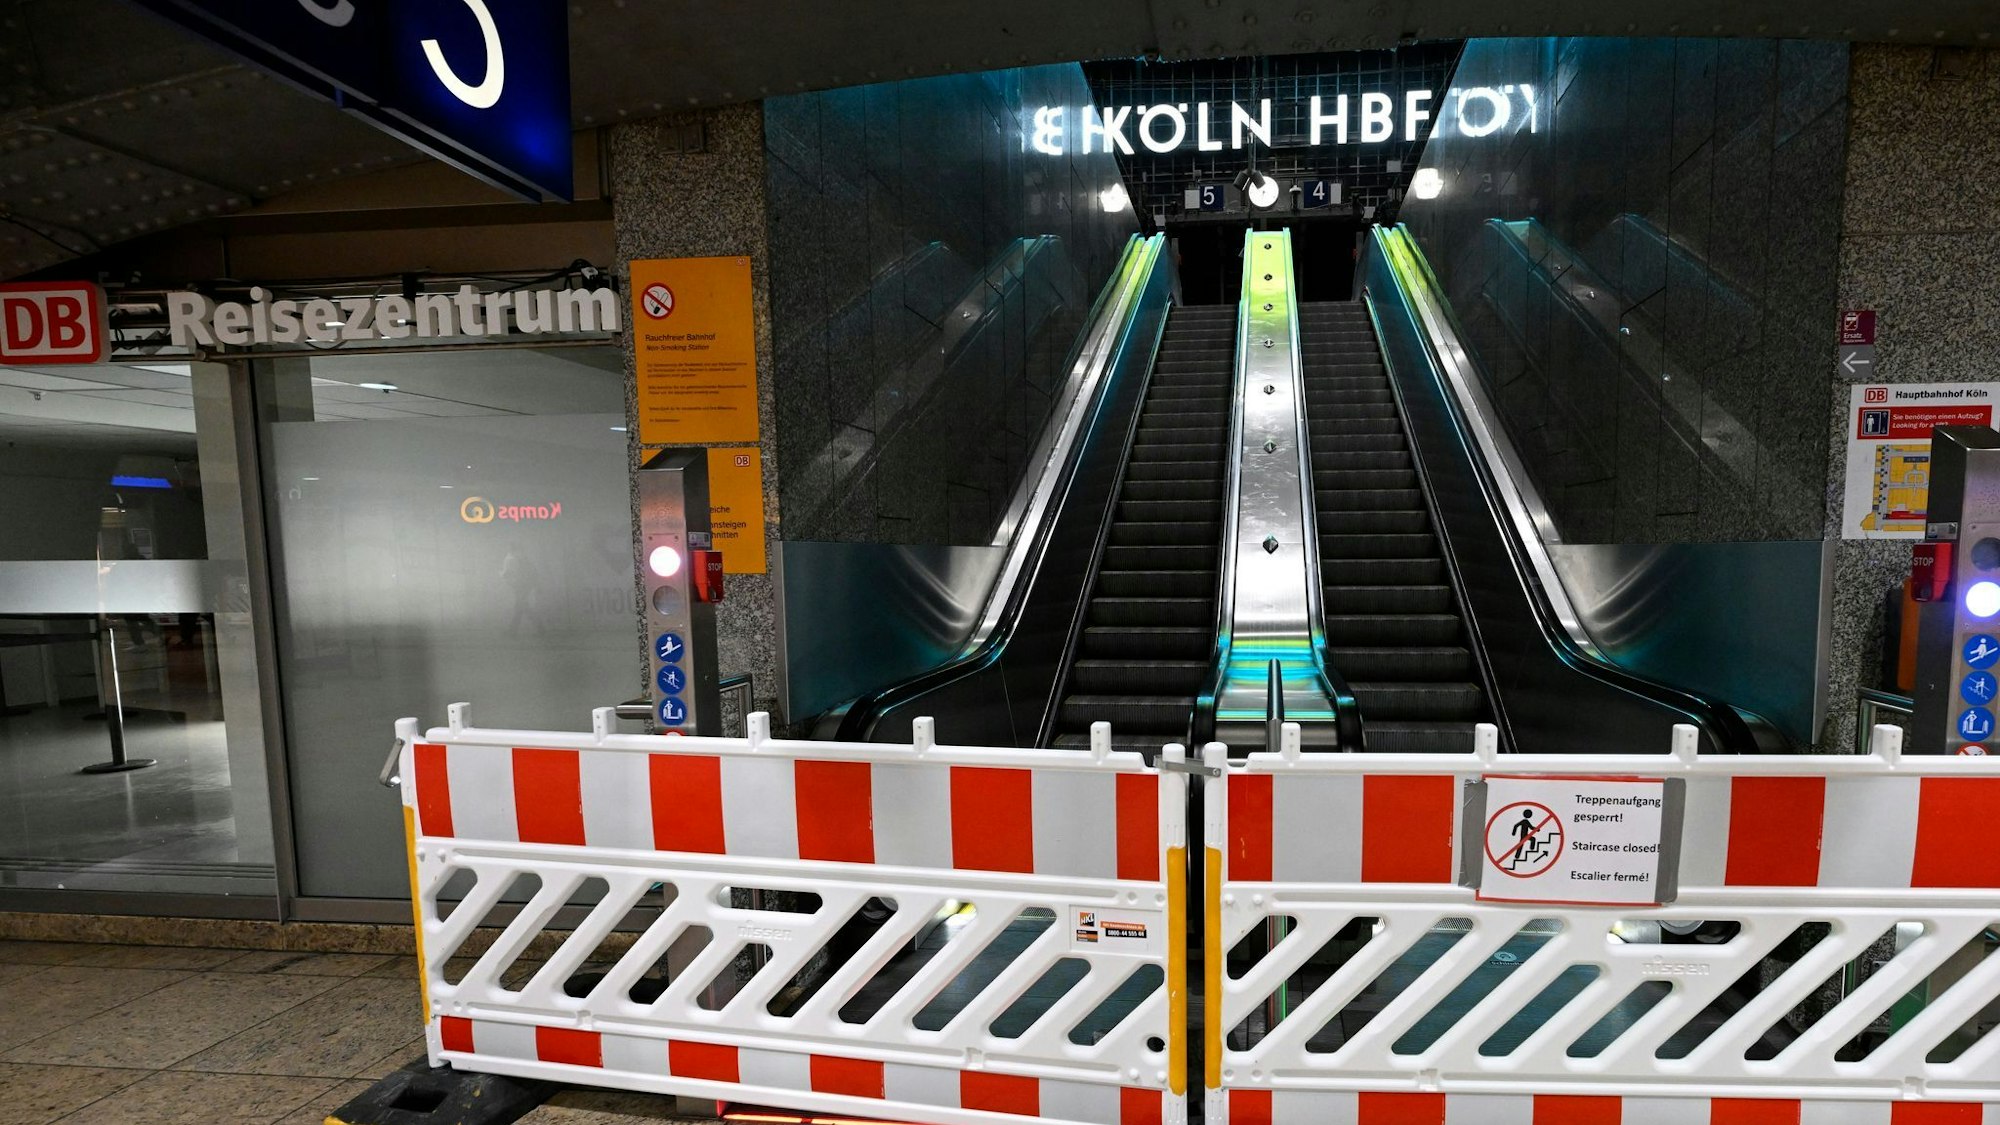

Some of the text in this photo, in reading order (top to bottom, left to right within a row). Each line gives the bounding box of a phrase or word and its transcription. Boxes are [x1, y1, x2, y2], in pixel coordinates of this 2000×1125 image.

[1103, 90, 1432, 155] KÖLN HBF
[1203, 186, 1215, 205] 5
[1312, 181, 1325, 200] 4
[166, 284, 620, 347] Reisezentrum
[4, 296, 86, 350] DB
[687, 333, 716, 341] Bahnhof
[1867, 390, 1885, 400] DB
[1895, 389, 1988, 400] Hauptbahnhof Köln
[1905, 413, 1936, 421] benötigen
[1957, 413, 1984, 421] Aufzug?
[1892, 422, 1918, 430] Looking
[1919, 422, 1929, 430] for
[736, 456, 749, 465] DB
[708, 562, 722, 572] STOP
[1913, 556, 1934, 567] STOP
[1575, 795, 1661, 808] Treppenaufgang
[1573, 812, 1623, 823] gesperrt!
[1571, 841, 1661, 853] Staircase closed!
[1570, 870, 1649, 882] Escalier fermé!
